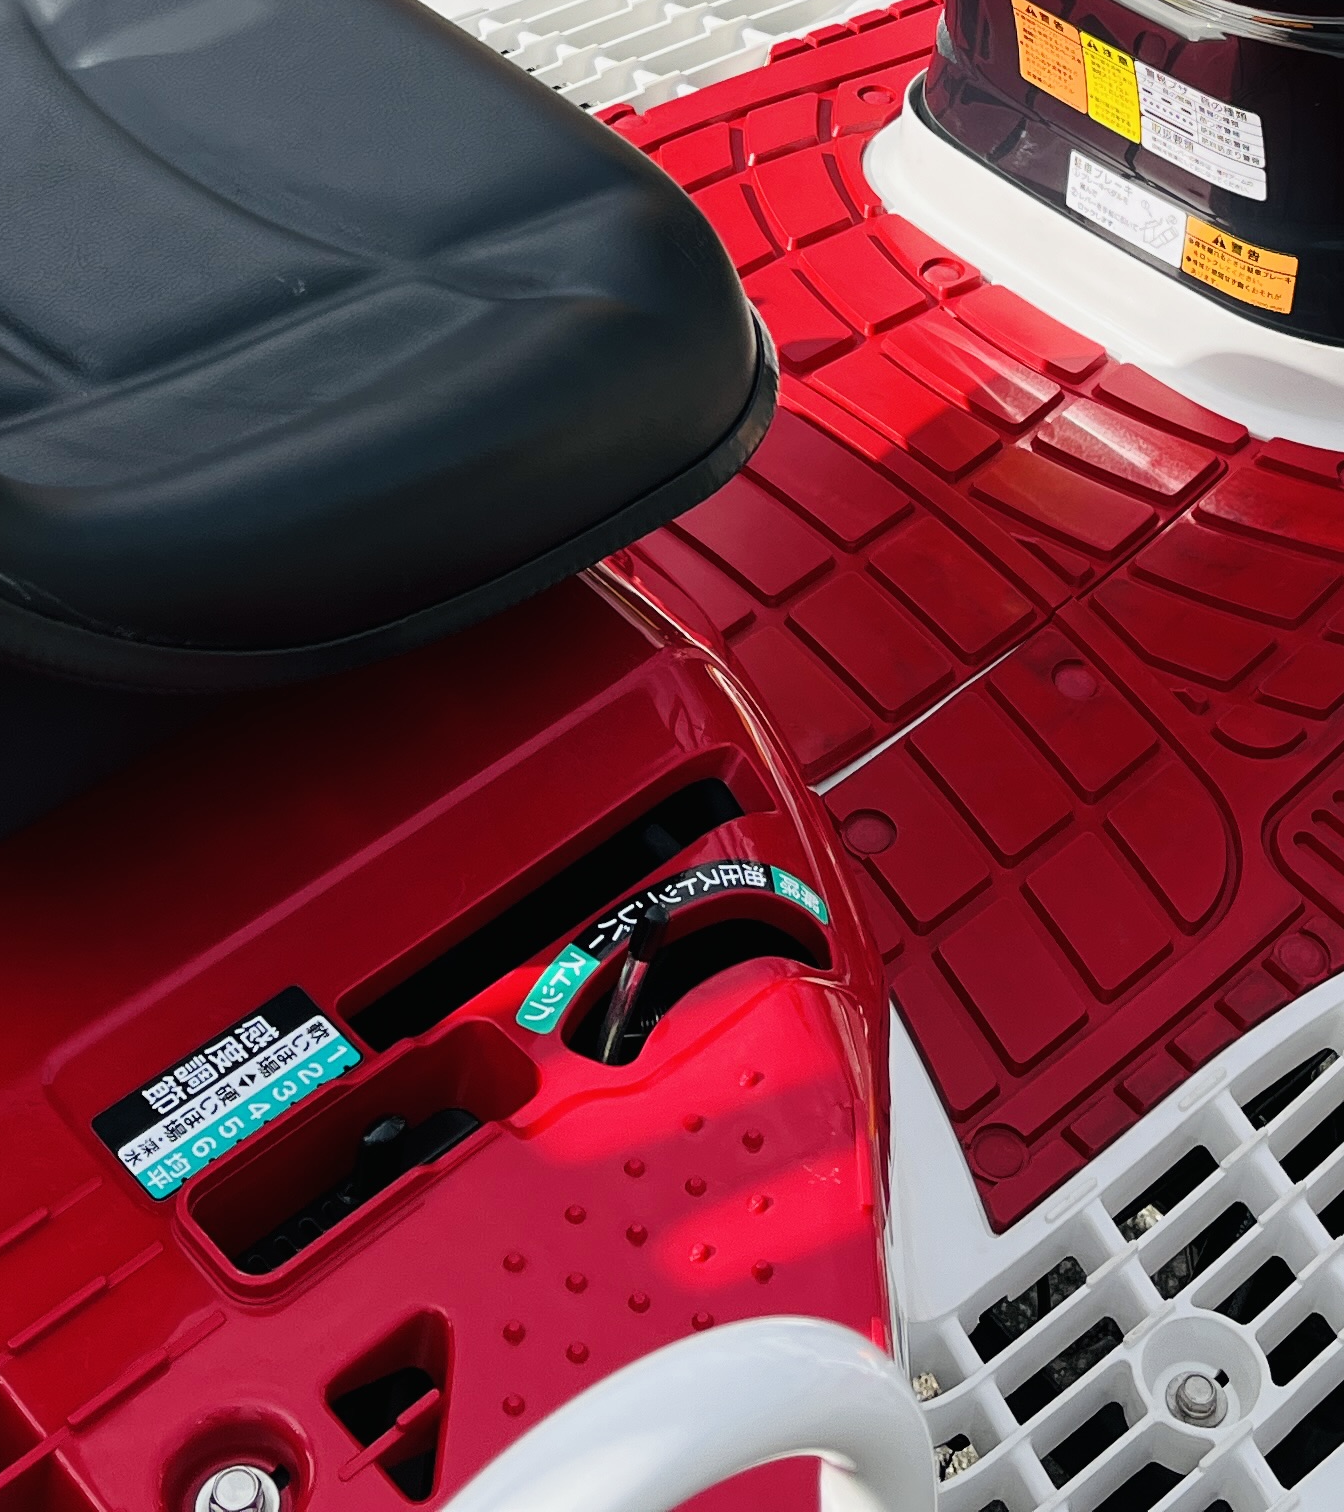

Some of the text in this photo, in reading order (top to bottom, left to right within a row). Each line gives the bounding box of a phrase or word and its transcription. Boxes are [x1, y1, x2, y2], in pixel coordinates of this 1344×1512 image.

[524, 950, 587, 1022] ストップ
[141, 1014, 281, 1116] 感度調節
[146, 1044, 349, 1191] 1 2 3 4 5 6 均平
